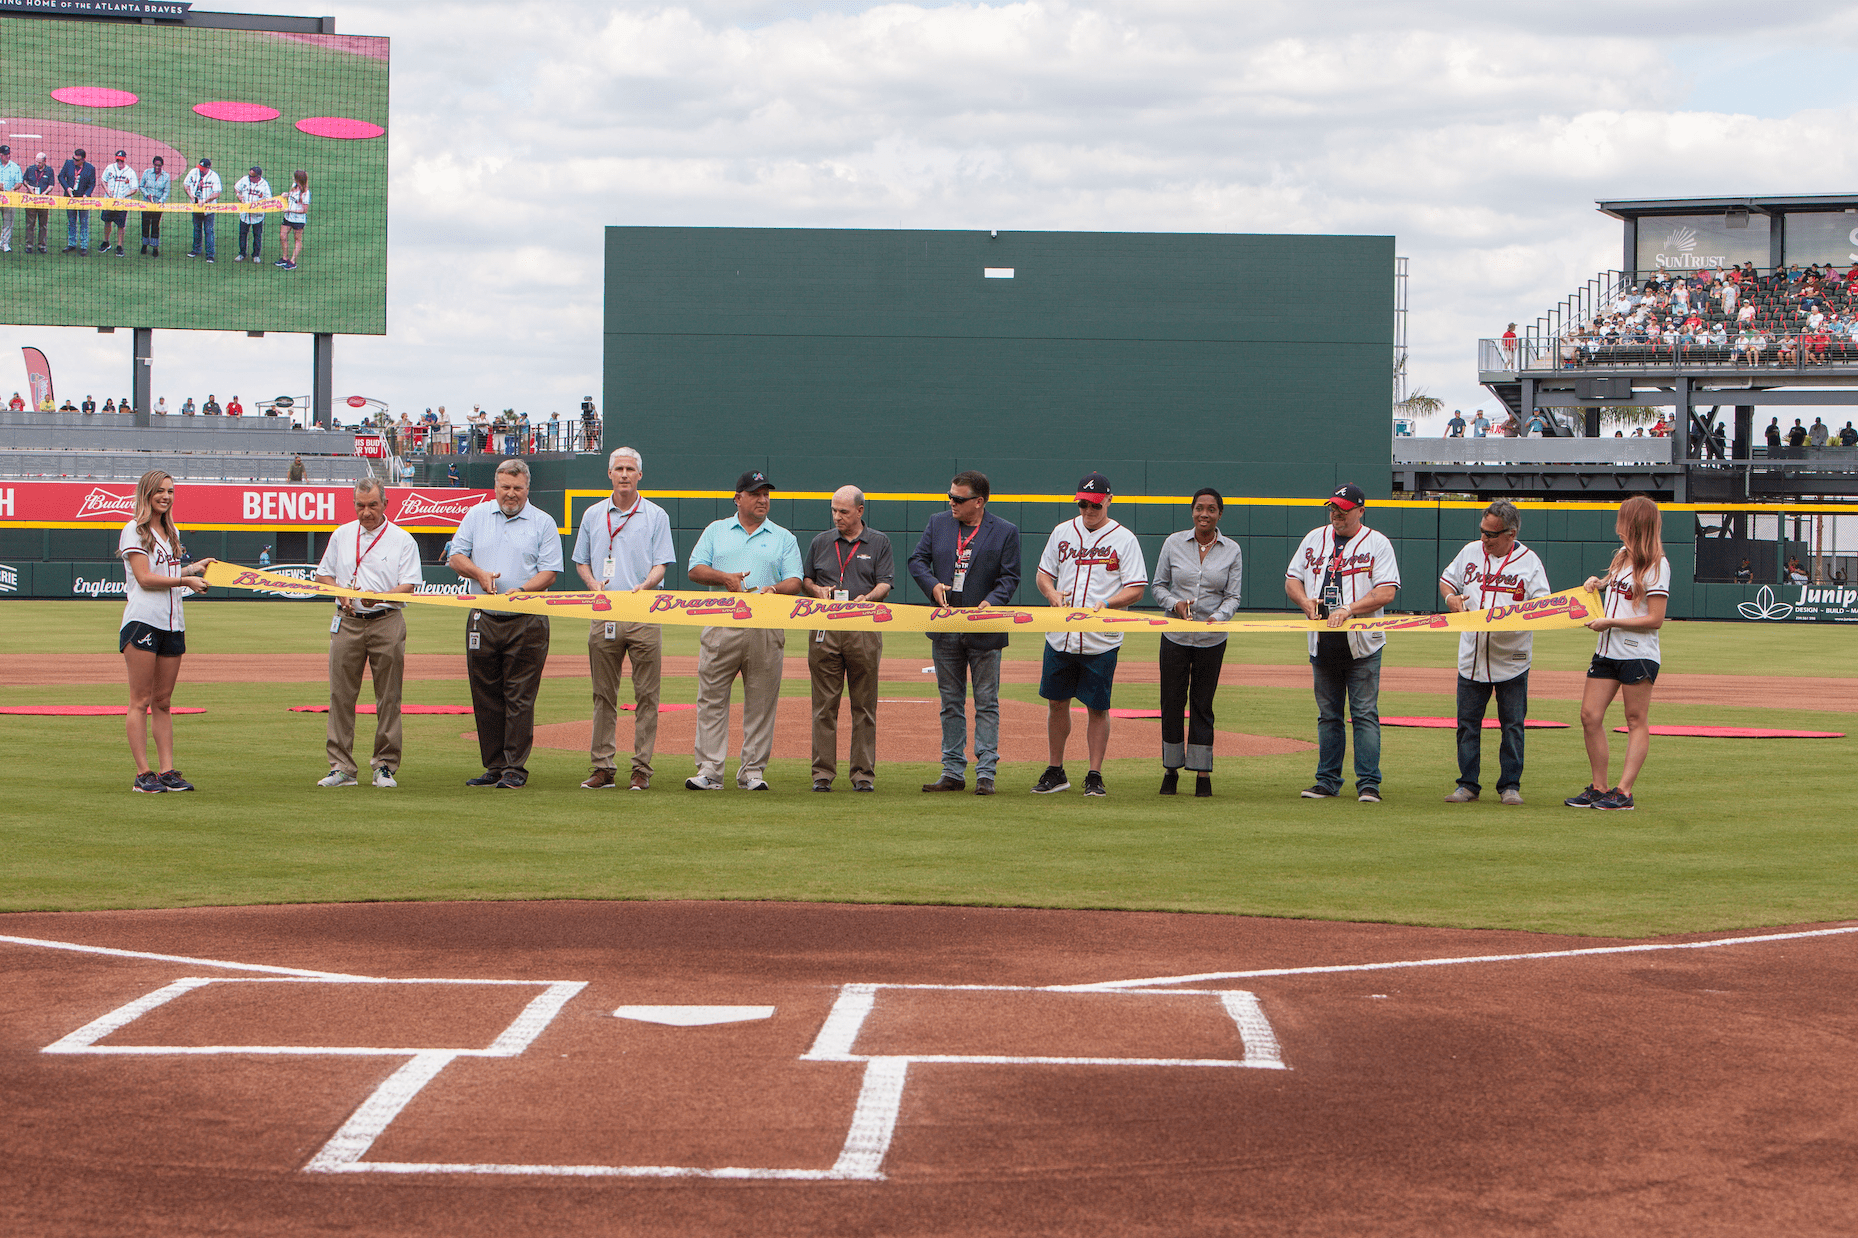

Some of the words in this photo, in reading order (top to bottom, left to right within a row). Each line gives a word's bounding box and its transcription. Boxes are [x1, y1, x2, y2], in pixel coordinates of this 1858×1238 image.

[26, 0, 57, 8] HOME
[61, 1, 72, 9] OF
[76, 2, 92, 10] THE
[95, 3, 141, 12] ATLANTA
[144, 5, 183, 14] BRAVES
[364, 446, 379, 455] YOU
[365, 438, 380, 447] BUD
[243, 491, 336, 521] BENCH
[1057, 540, 1111, 564] Braves
[1463, 562, 1519, 586] Braves
[649, 594, 735, 613] Braves
[789, 598, 875, 619] Braves
[1486, 594, 1568, 623] Braves
